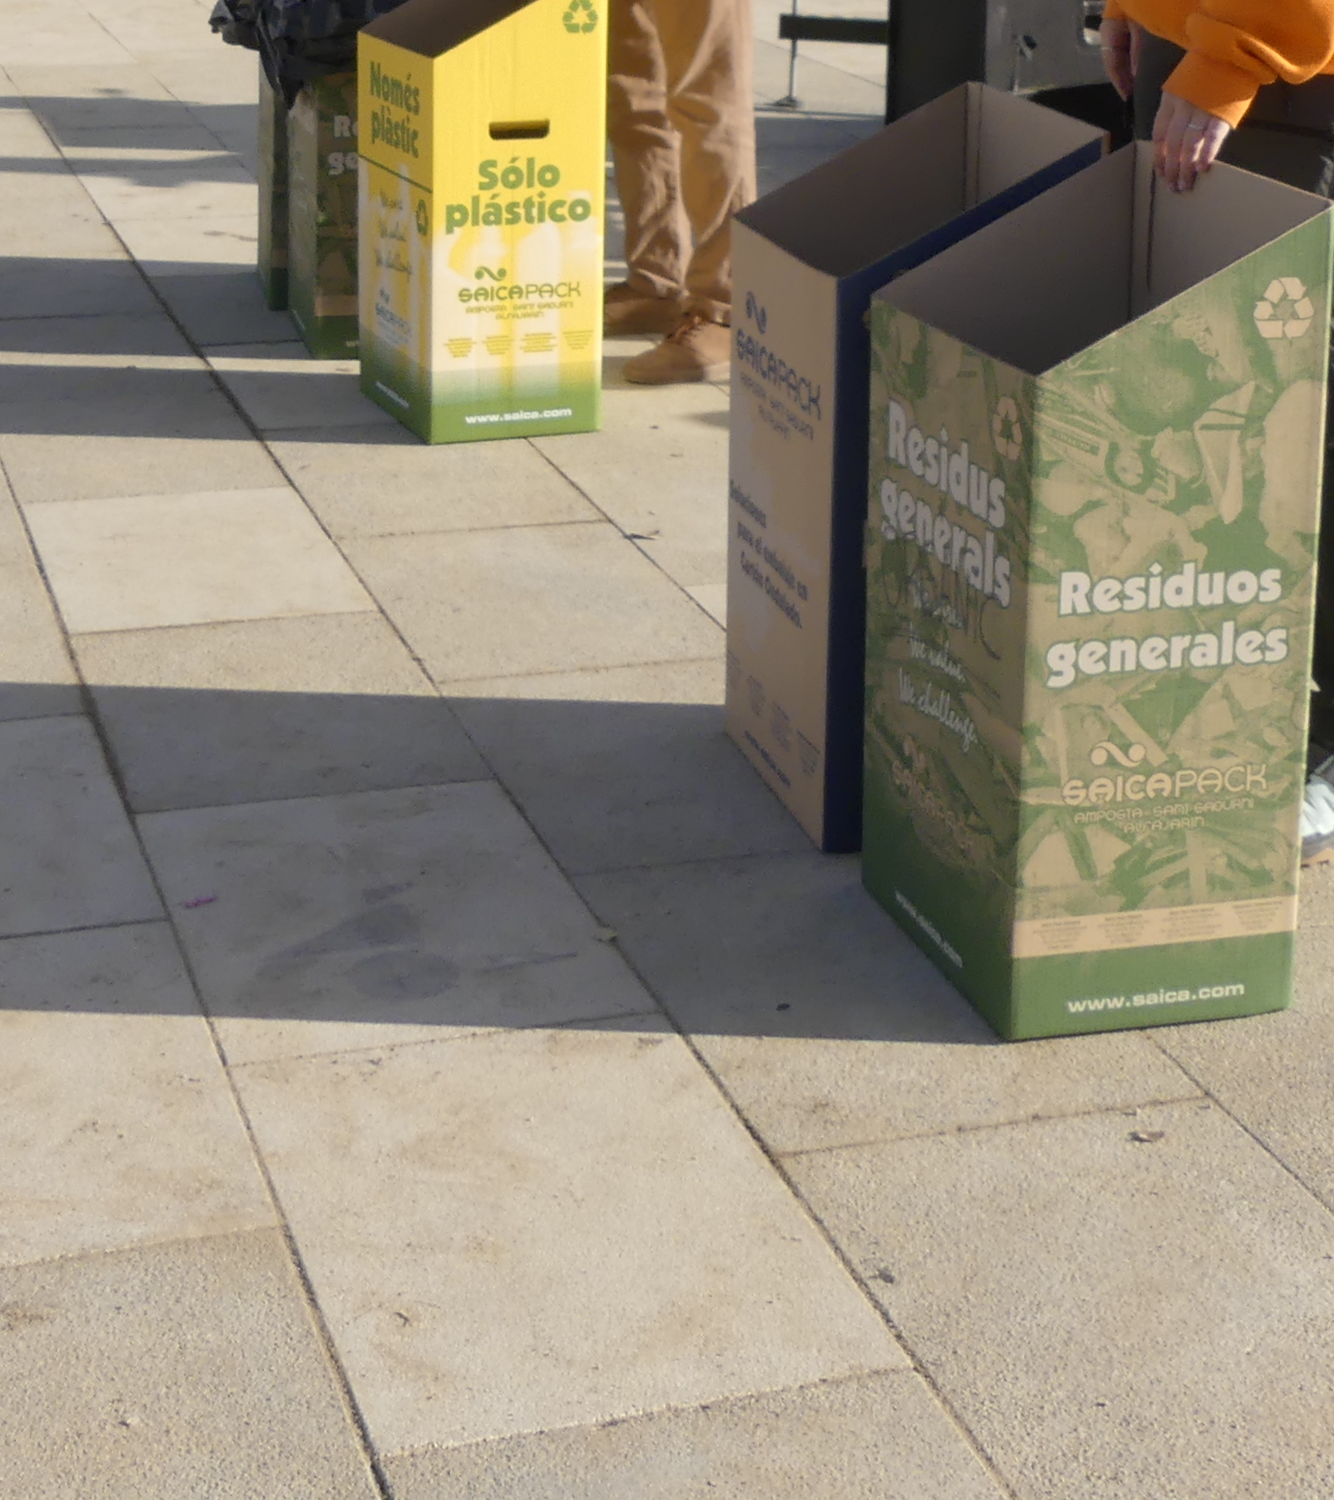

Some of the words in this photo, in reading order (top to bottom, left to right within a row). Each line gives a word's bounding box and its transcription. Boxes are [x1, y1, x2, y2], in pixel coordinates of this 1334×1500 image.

[370, 61, 420, 116] Només
[371, 105, 419, 159] plàstic
[478, 156, 561, 191] Sólo
[445, 190, 592, 235] plástico
[458, 282, 582, 304] SAICAPACK
[736, 328, 822, 422] SAICAPACK
[465, 407, 573, 425] www.saica.com
[886, 399, 1006, 529] Residus
[880, 477, 1011, 610] generals
[1058, 560, 1283, 617] Residuos
[1044, 620, 1289, 689] generales
[1062, 763, 1267, 807] SAICAPACK
[1067, 982, 1245, 1014] www.saica.com
